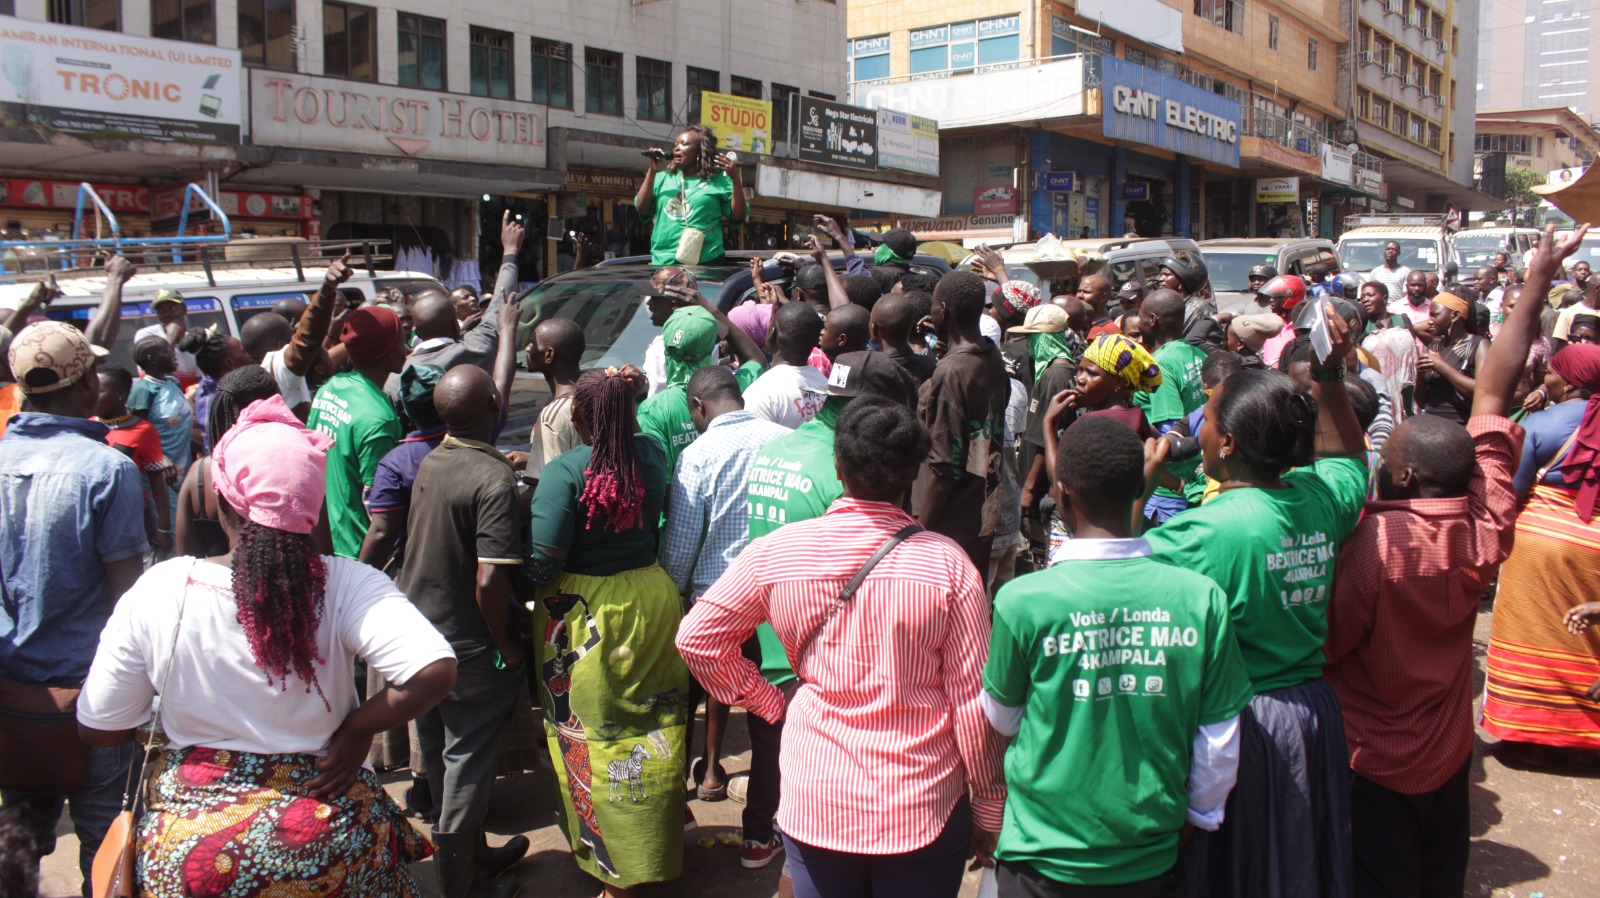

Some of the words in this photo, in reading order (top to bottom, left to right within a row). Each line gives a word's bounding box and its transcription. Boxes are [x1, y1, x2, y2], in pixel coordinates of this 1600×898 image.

[60, 36, 165, 60] INTERNATIONAL
[188, 54, 232, 68] LIMITED
[56, 69, 181, 103] TRONIC
[264, 77, 429, 135] TOURIST
[438, 97, 545, 145] HOTEL
[711, 104, 766, 130] STUDIO
[825, 108, 839, 119] Mega
[839, 111, 850, 120] Star
[850, 112, 874, 125] Electricals
[1113, 84, 1160, 121] CHNT
[1165, 98, 1237, 145] ELECTRIC
[591, 175, 633, 186] WINNER
[970, 214, 1014, 226] Genuine
[784, 471, 814, 494] MAO
[1069, 610, 1106, 628] Vote
[1109, 607, 1119, 623] /
[1123, 606, 1171, 623] Londa
[1043, 625, 1145, 657] BEATRICE
[1150, 626, 1198, 648] MAO
[1077, 649, 1167, 671] 4KAMPALA
